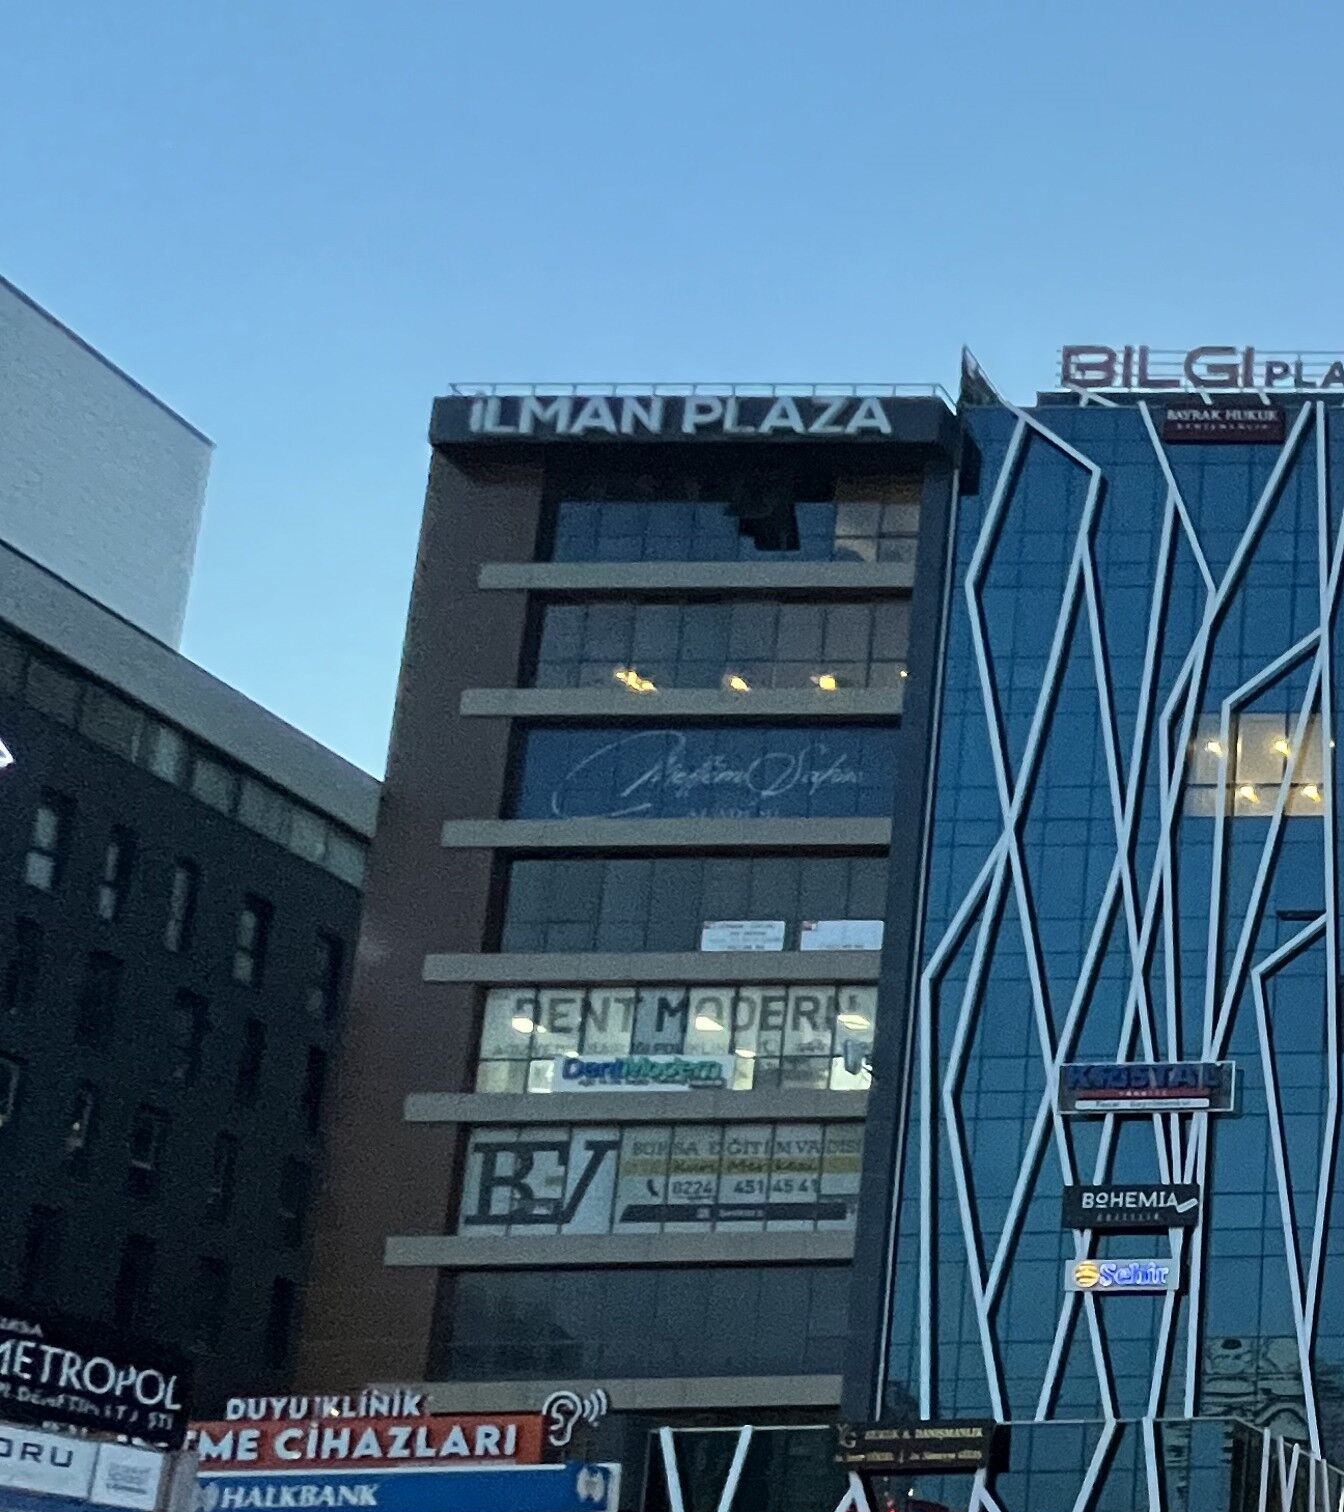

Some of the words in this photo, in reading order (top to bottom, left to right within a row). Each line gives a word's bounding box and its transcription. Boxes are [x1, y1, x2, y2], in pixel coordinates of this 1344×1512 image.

[681, 395, 893, 434] PLAZA
[226, 1397, 309, 1421] DUYU
[220, 1483, 379, 1509] HALKBANK
